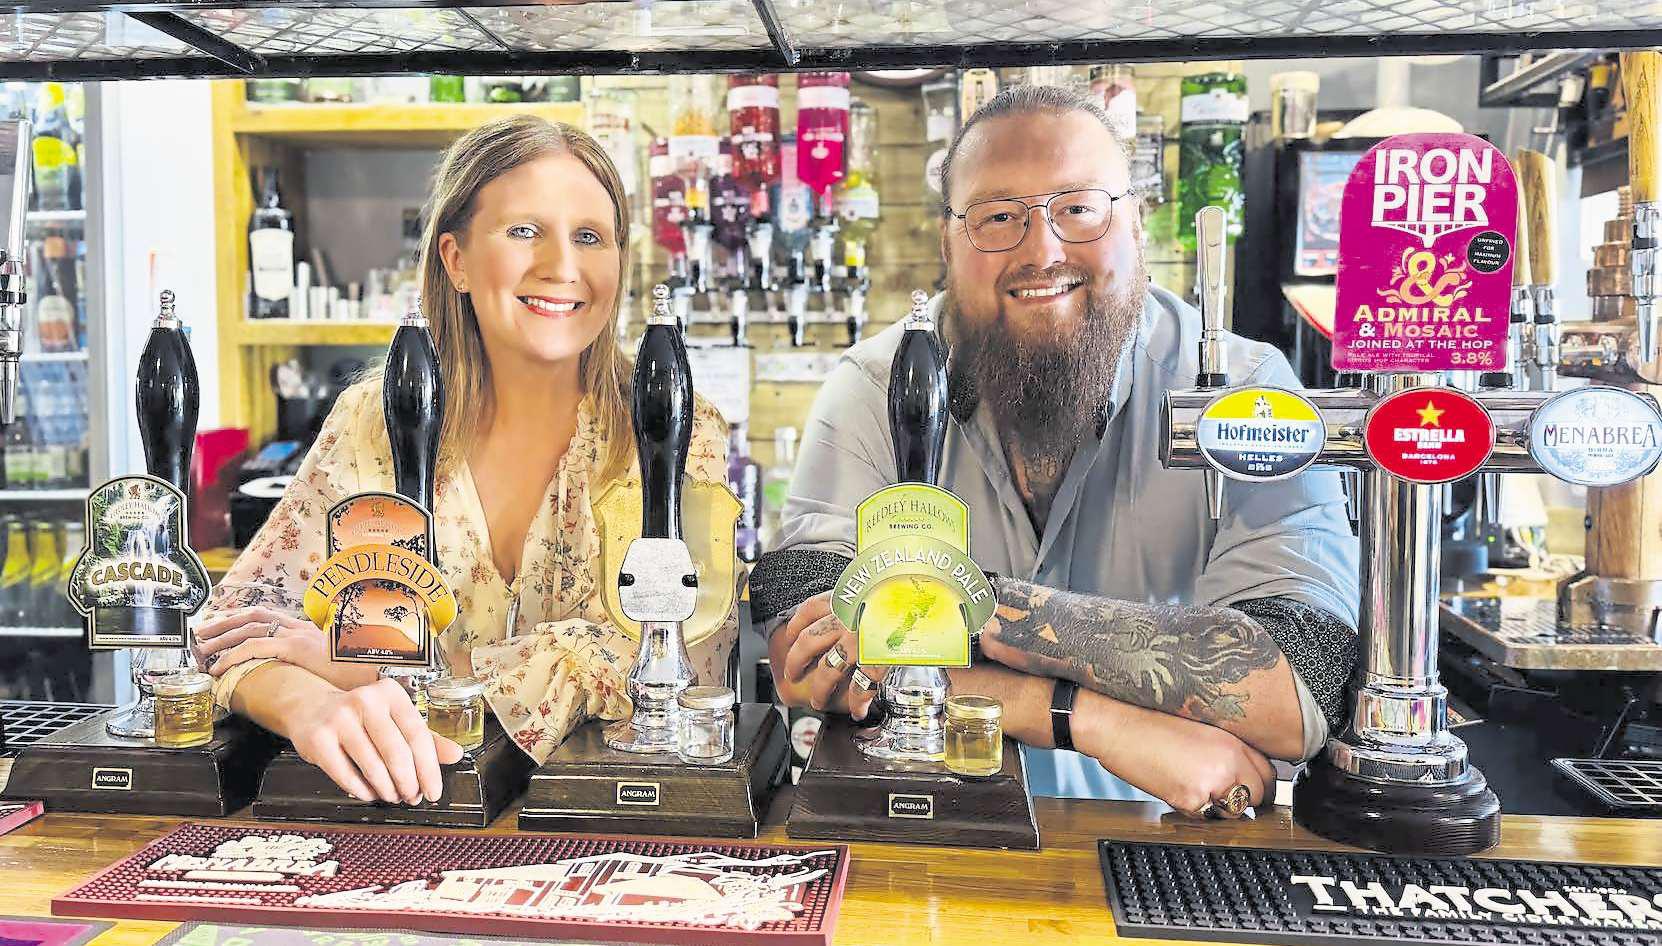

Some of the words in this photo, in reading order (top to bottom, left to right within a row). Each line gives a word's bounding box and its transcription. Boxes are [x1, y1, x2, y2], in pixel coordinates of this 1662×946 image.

[1374, 148, 1493, 184] IRON
[1374, 184, 1488, 222] PIER
[1353, 305, 1492, 322] ADMIRAL
[1359, 323, 1375, 338] &
[1384, 323, 1479, 338] MOSAIC
[1348, 340, 1401, 349] JOINED
[1405, 340, 1425, 349] AT
[1428, 340, 1456, 349] THE
[1462, 340, 1493, 349] HOP
[1451, 352, 1493, 365] 3.8%
[1217, 422, 1309, 443] Hofmeister
[1393, 428, 1465, 442] ESTRELLA
[1543, 424, 1657, 448] MENABREA
[1239, 453, 1283, 462] HELLES
[91, 562, 184, 587] CASCADE
[311, 551, 448, 603] PENDLESIDE
[838, 564, 872, 605] NEW
[870, 545, 952, 574] ZEALAND
[950, 562, 989, 605] PALE
[893, 802, 928, 810] ANGRAM
[1290, 875, 1662, 924] THATCHER
[1356, 905, 1404, 917] THE
[1410, 907, 1492, 922] FAMILY
[1502, 912, 1574, 926] CIDER
